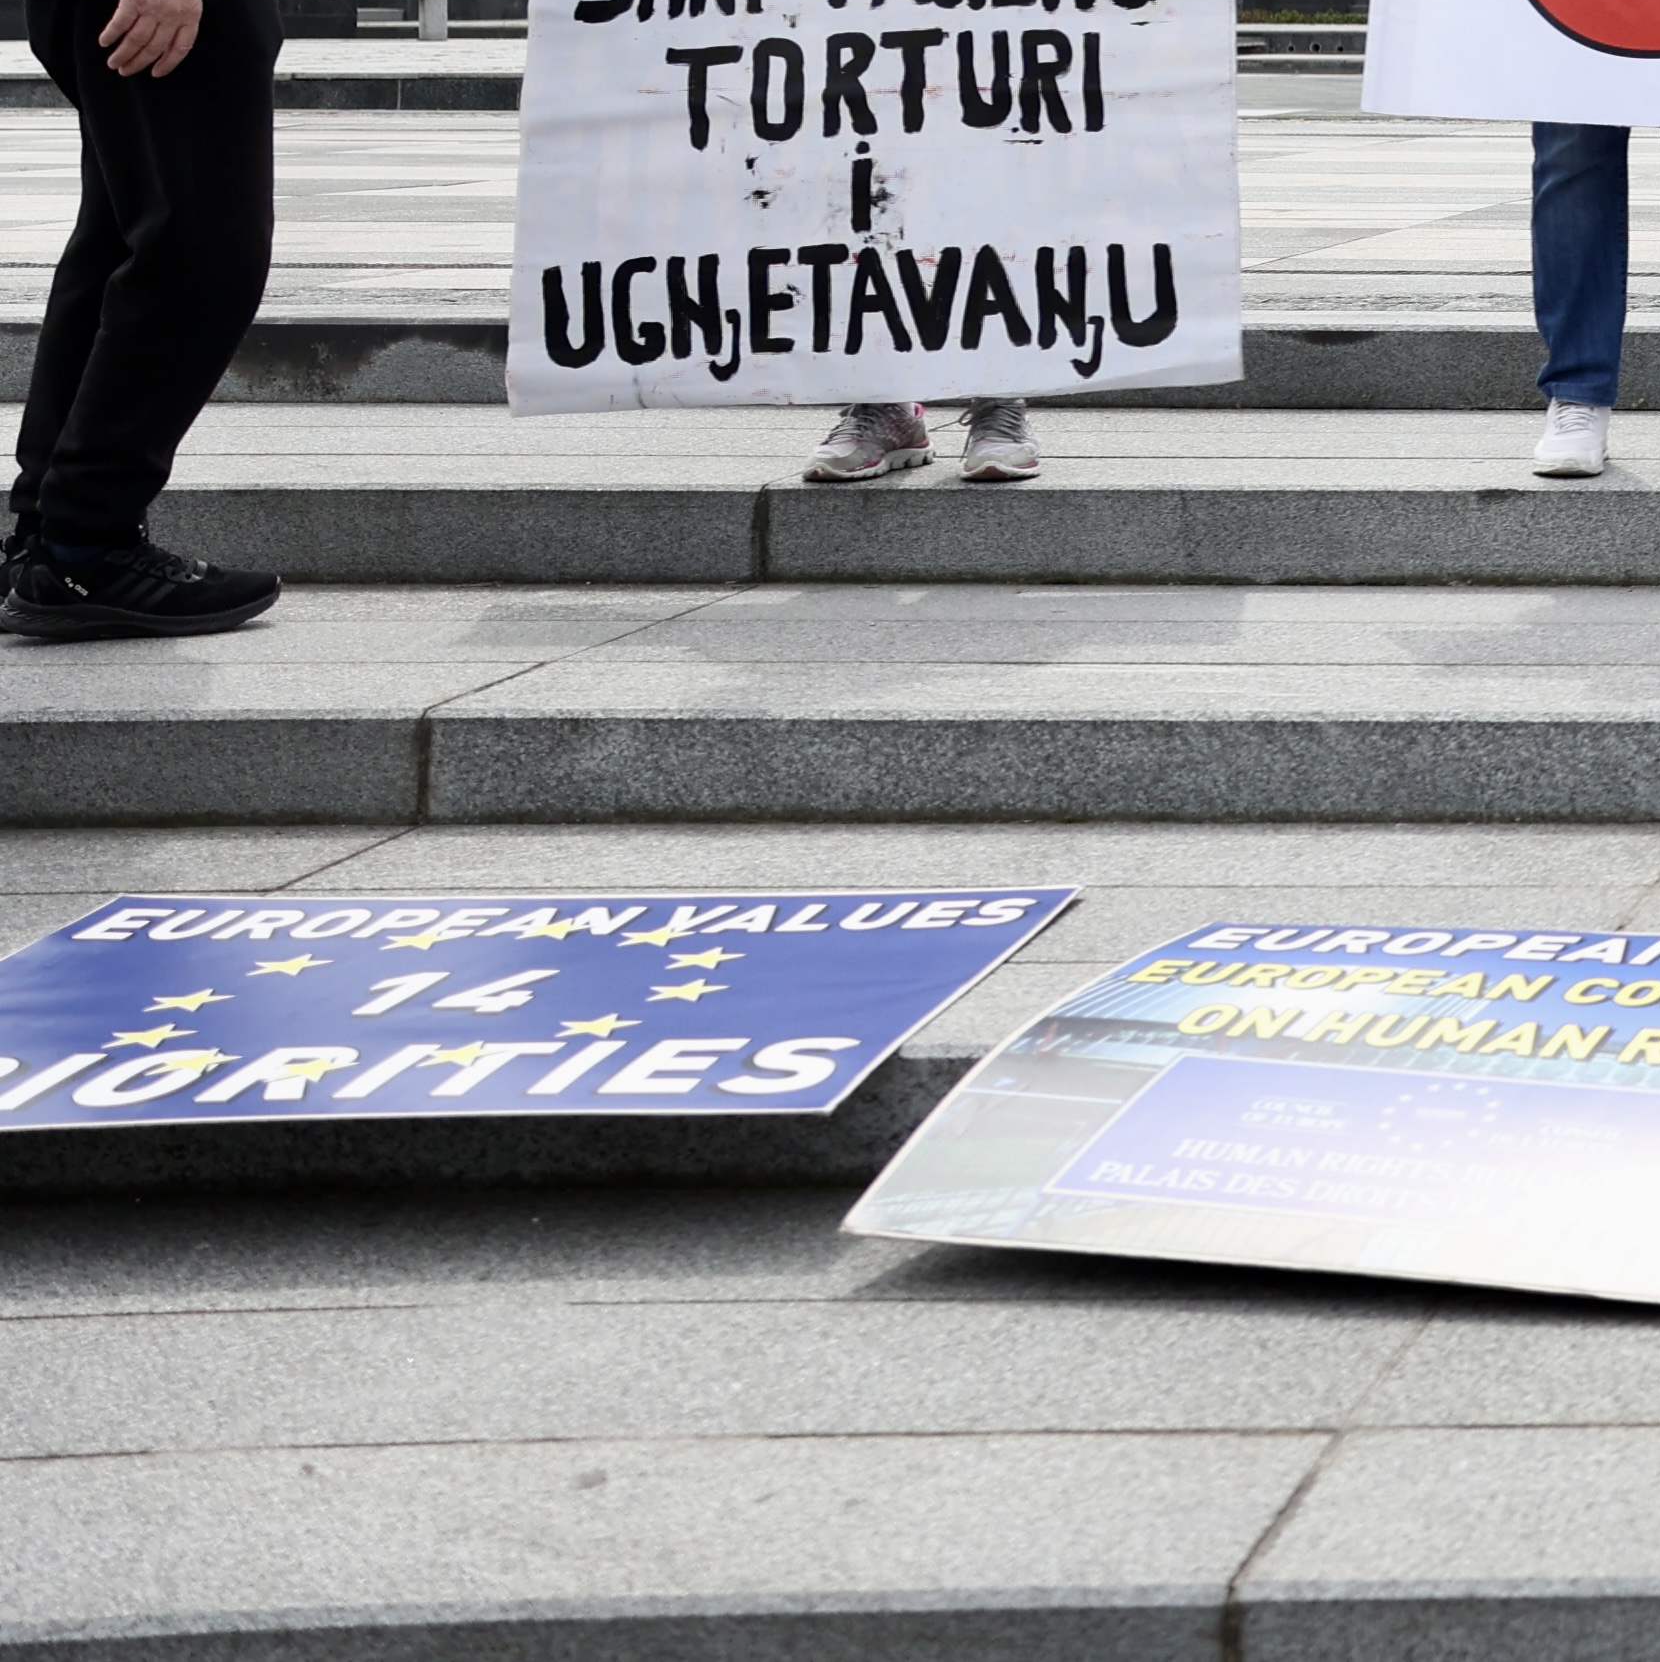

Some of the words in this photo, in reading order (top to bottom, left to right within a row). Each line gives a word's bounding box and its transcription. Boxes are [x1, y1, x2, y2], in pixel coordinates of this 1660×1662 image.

[666, 28, 1105, 150] TORTURI
[72, 907, 649, 941] EUROPEAN
[662, 898, 1040, 935] VALUES
[352, 968, 562, 1017] 14
[1124, 959, 1556, 1002] EUROPEAN
[1176, 1003, 1304, 1040] ON
[1302, 1011, 1611, 1062] HUMAN
[0, 1035, 862, 1111] IORITIES
[1086, 1160, 1222, 1190] PALAIS
[1222, 1173, 1300, 1199] DES
[1170, 1138, 1314, 1169] HUMAN
[1315, 1151, 1455, 1181] RIGHTS
